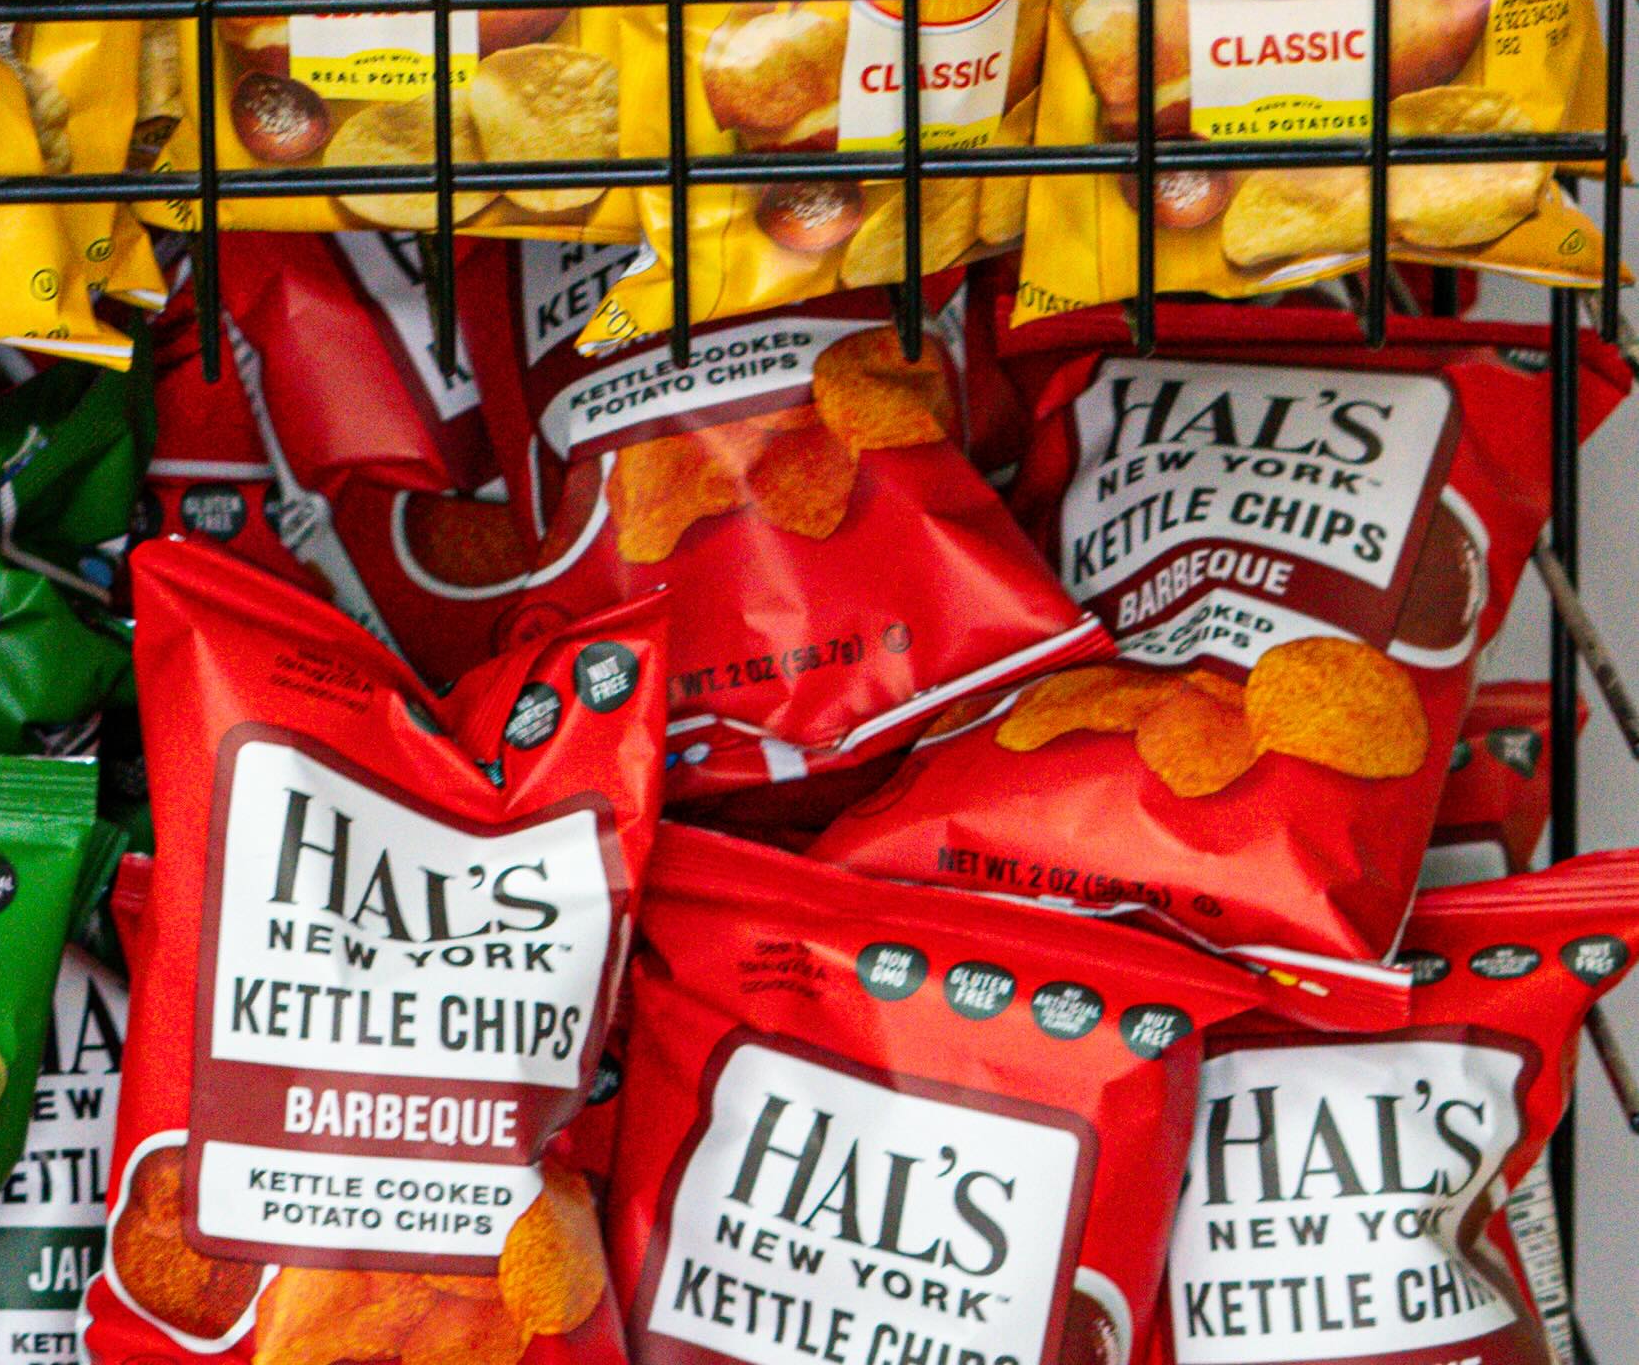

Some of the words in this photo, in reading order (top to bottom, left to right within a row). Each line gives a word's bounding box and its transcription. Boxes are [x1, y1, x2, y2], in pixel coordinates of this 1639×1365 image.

[1210, 29, 1367, 68] CLASSIC
[1267, 113, 1372, 133] POTATOES
[569, 361, 676, 411] KETTLE
[687, 332, 812, 368] COOKED
[586, 376, 697, 422] POTATO
[705, 352, 801, 391] CHIPS
[1099, 374, 1393, 467] HAL'S
[1096, 448, 1197, 504] NEW
[1221, 450, 1367, 496] YORK
[1072, 487, 1218, 586] KETTLE
[1228, 491, 1389, 567] CHIPS
[1116, 547, 1295, 632] BARBEQUE
[267, 787, 560, 943] HAL'S
[266, 918, 379, 972] NEW
[405, 941, 556, 974] YORK
[949, 966, 1011, 994] GLUTEN
[229, 975, 418, 1050] KETTLE
[438, 993, 580, 1061] CHIPS
[955, 982, 995, 1010] FREE
[284, 1085, 518, 1149] BARBEQUE
[1203, 1079, 1488, 1205] HAL'S
[248, 1168, 363, 1200] KETTLE
[374, 1176, 514, 1208] COOKED
[261, 1200, 381, 1233] POTATO
[395, 1206, 494, 1236] CHIPS
[726, 1092, 1017, 1277] HAL'S
[1206, 1218, 1327, 1253] NEW
[715, 1217, 826, 1276] NEW
[852, 1258, 994, 1327] YORK
[1183, 1271, 1375, 1339] KETTLE
[673, 1259, 854, 1359] KETTLE
